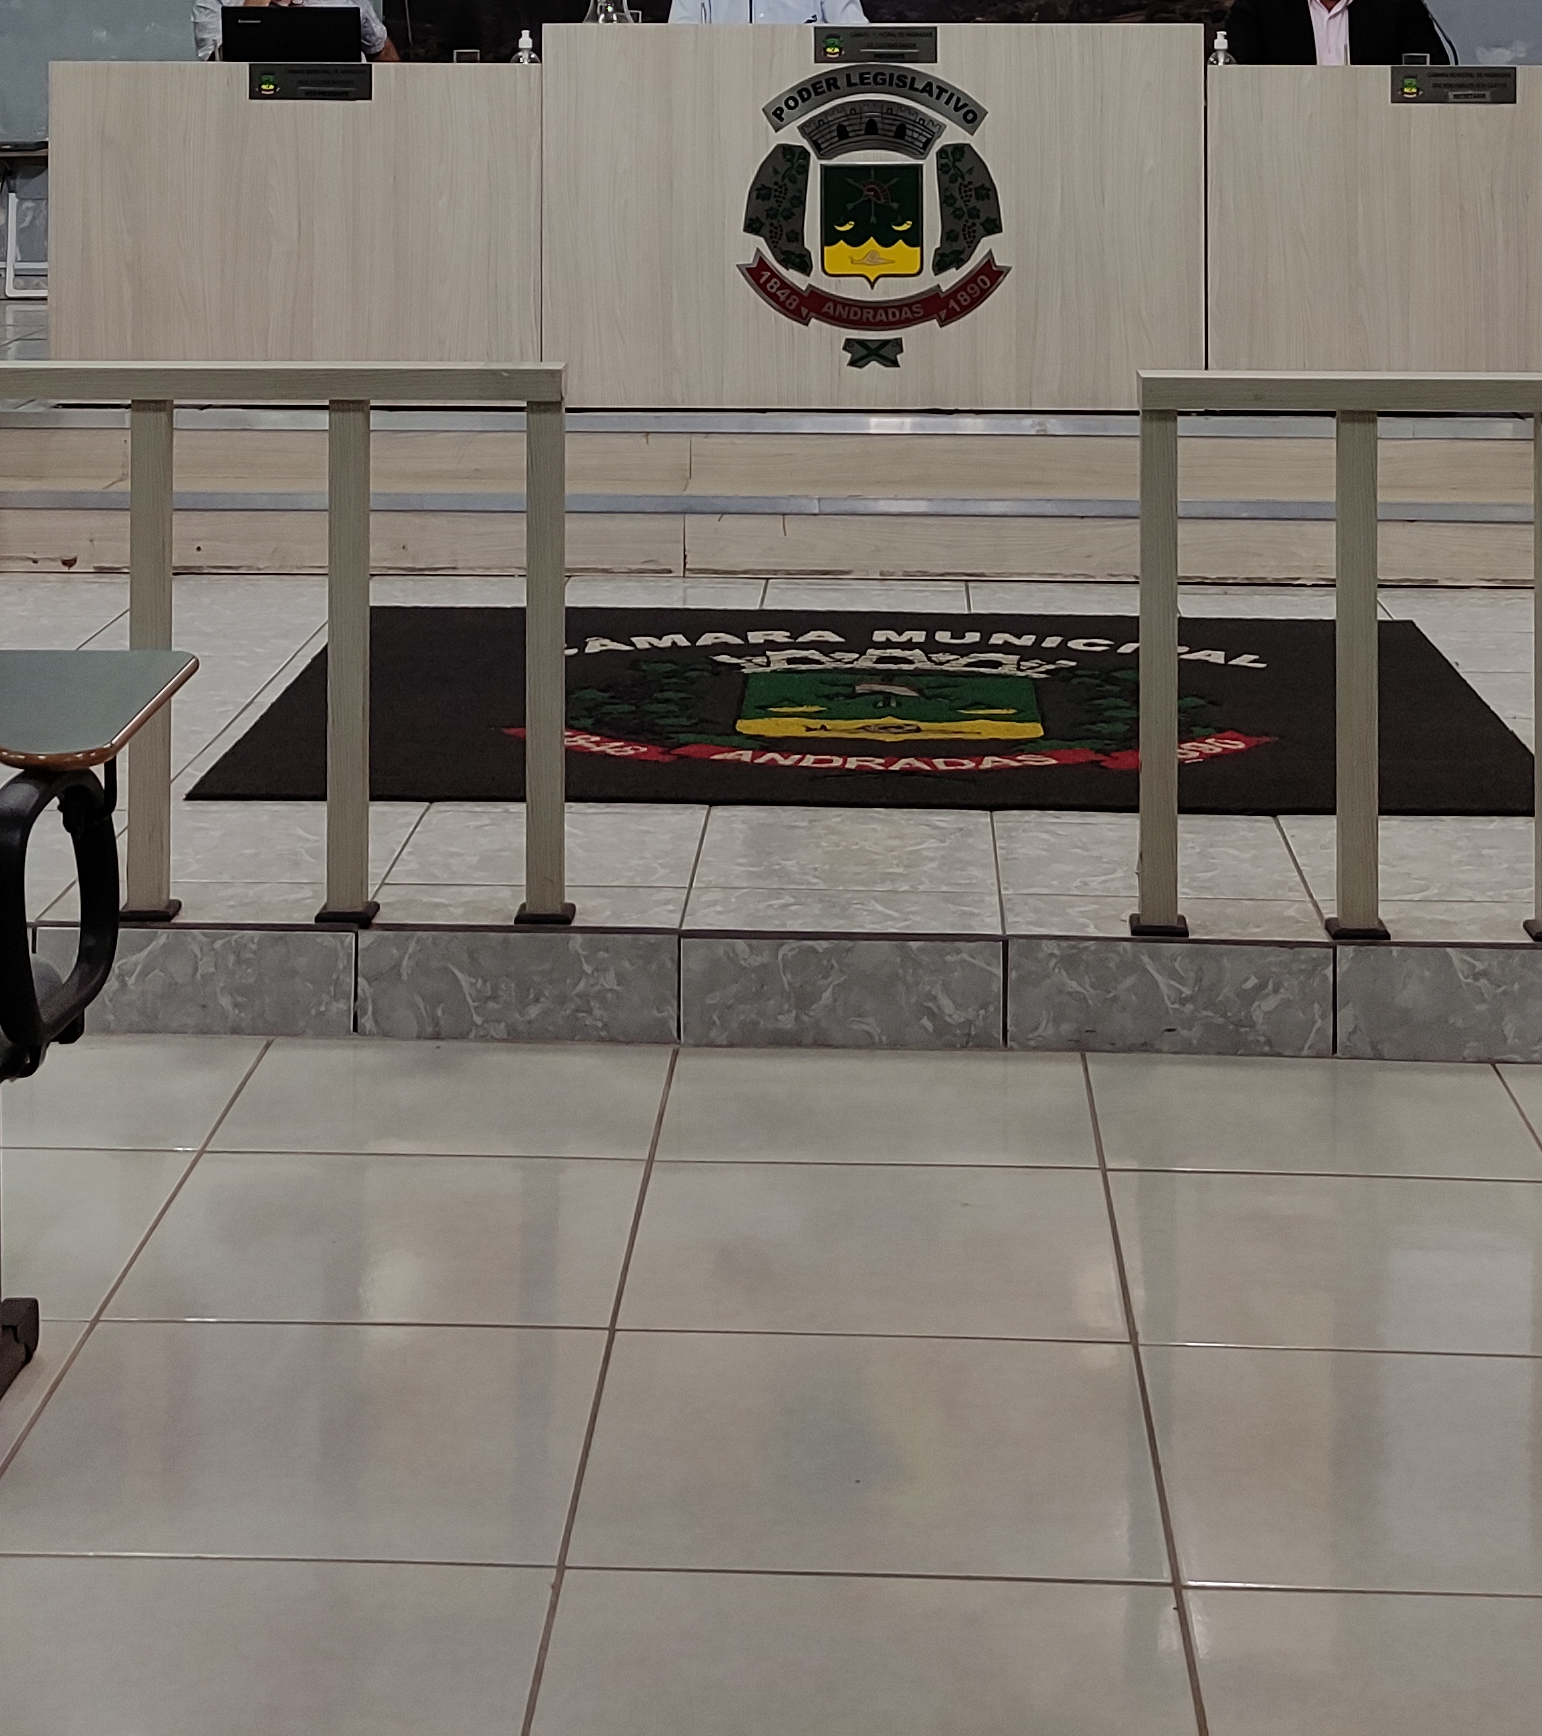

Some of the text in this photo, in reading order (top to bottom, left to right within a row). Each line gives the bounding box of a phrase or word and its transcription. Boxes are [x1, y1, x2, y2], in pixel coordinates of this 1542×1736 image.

[771, 70, 979, 125] PODER LEGISLATIVO
[759, 269, 800, 310] 1848
[947, 273, 991, 313] 1890
[821, 300, 925, 323] ANDRADAS
[872, 630, 1268, 669] MUNICIAL
[564, 732, 648, 757] 848
[708, 750, 1060, 771] ANDRADAS
